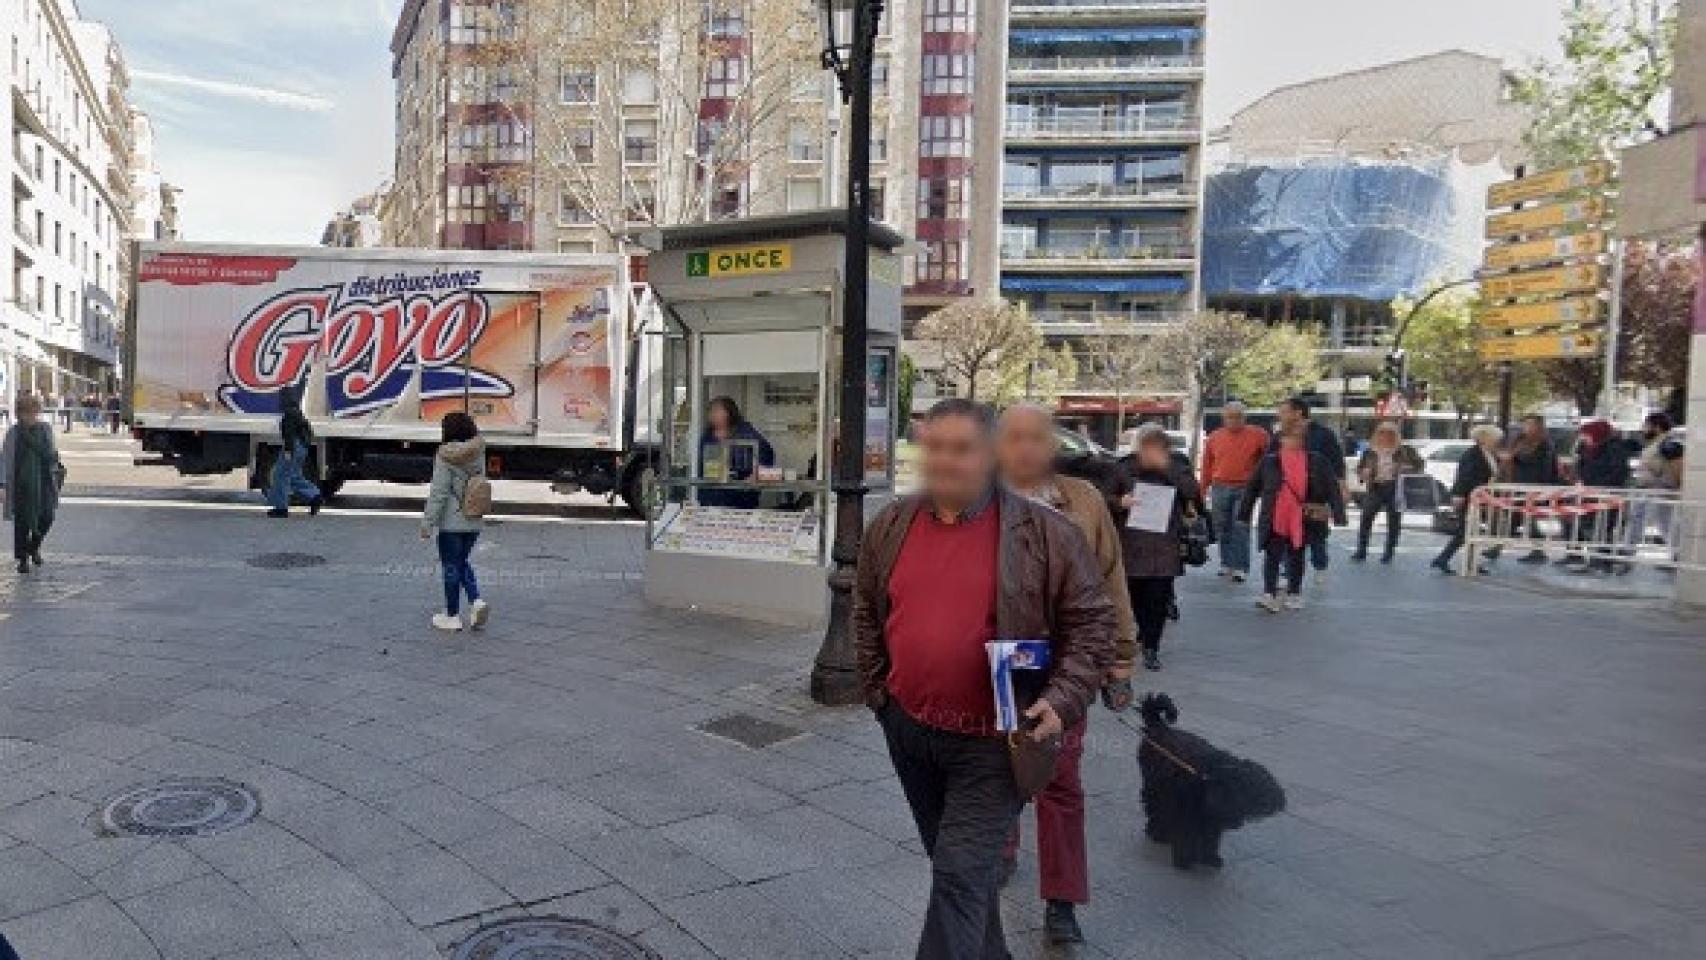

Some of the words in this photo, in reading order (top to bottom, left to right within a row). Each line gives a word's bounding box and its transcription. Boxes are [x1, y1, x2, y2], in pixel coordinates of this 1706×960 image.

[717, 249, 783, 272] ONCE
[348, 269, 483, 297] distribuciones
[228, 285, 489, 398] Goyo
